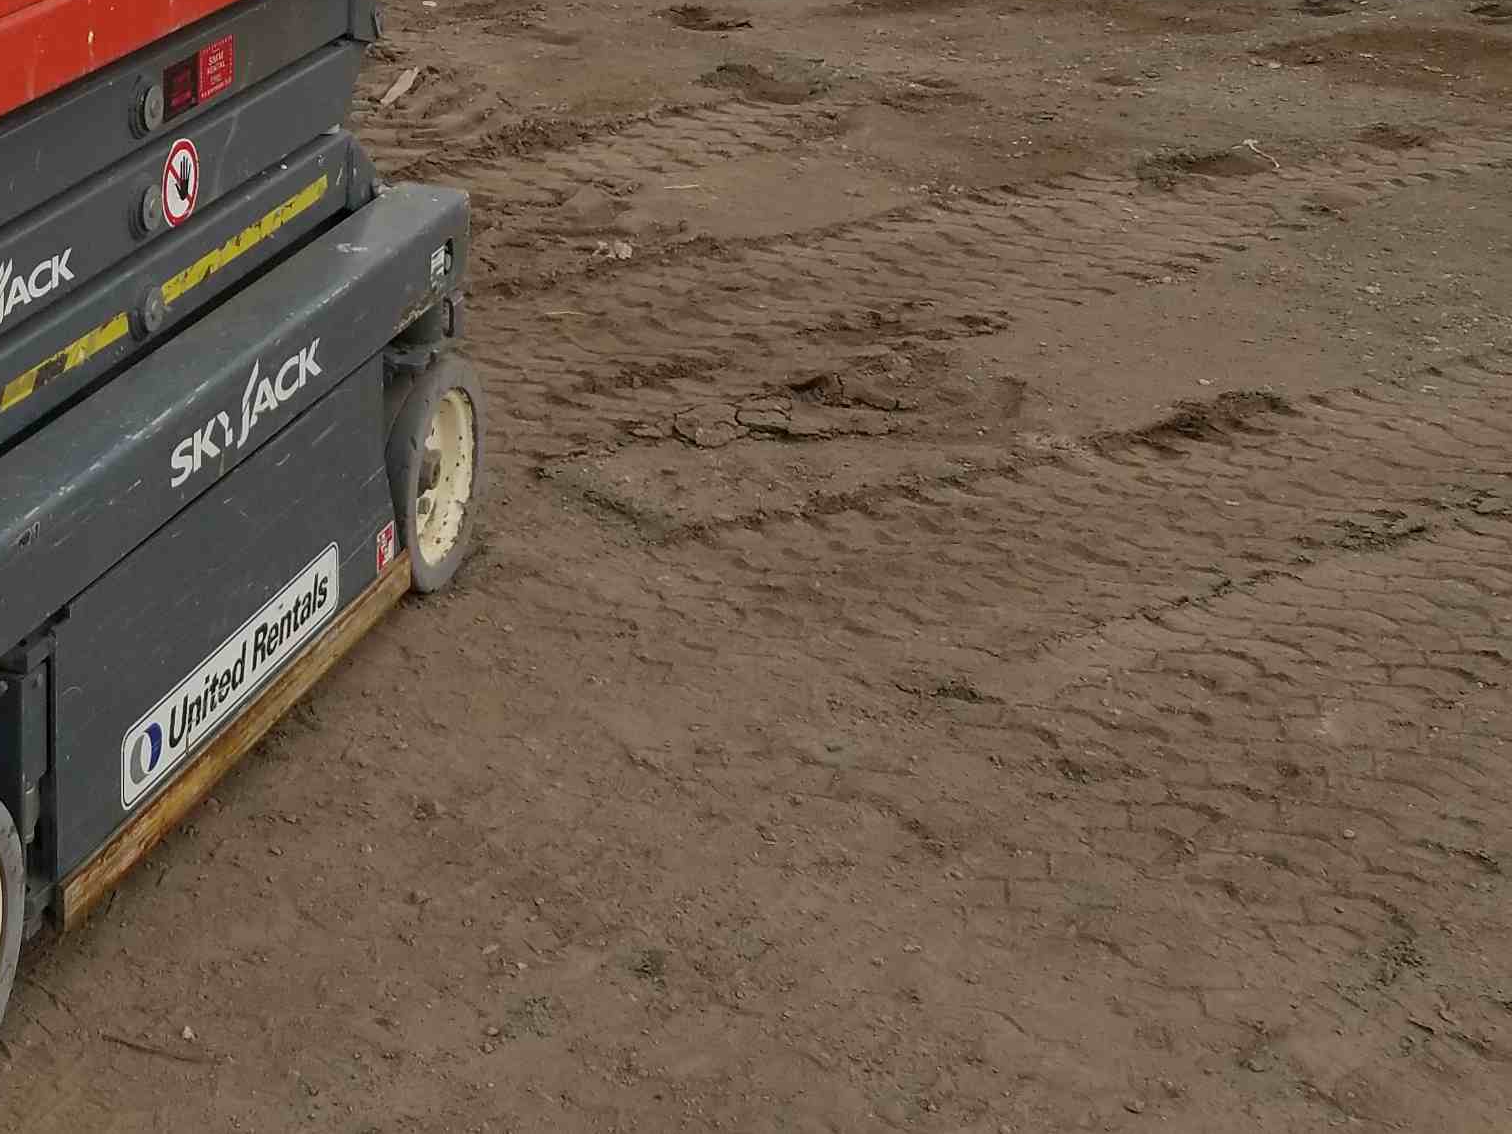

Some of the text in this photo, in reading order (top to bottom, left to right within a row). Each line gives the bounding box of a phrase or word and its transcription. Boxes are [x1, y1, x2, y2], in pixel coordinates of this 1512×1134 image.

[170, 337, 322, 488] SKYJACK
[167, 572, 328, 750] United Rentals
